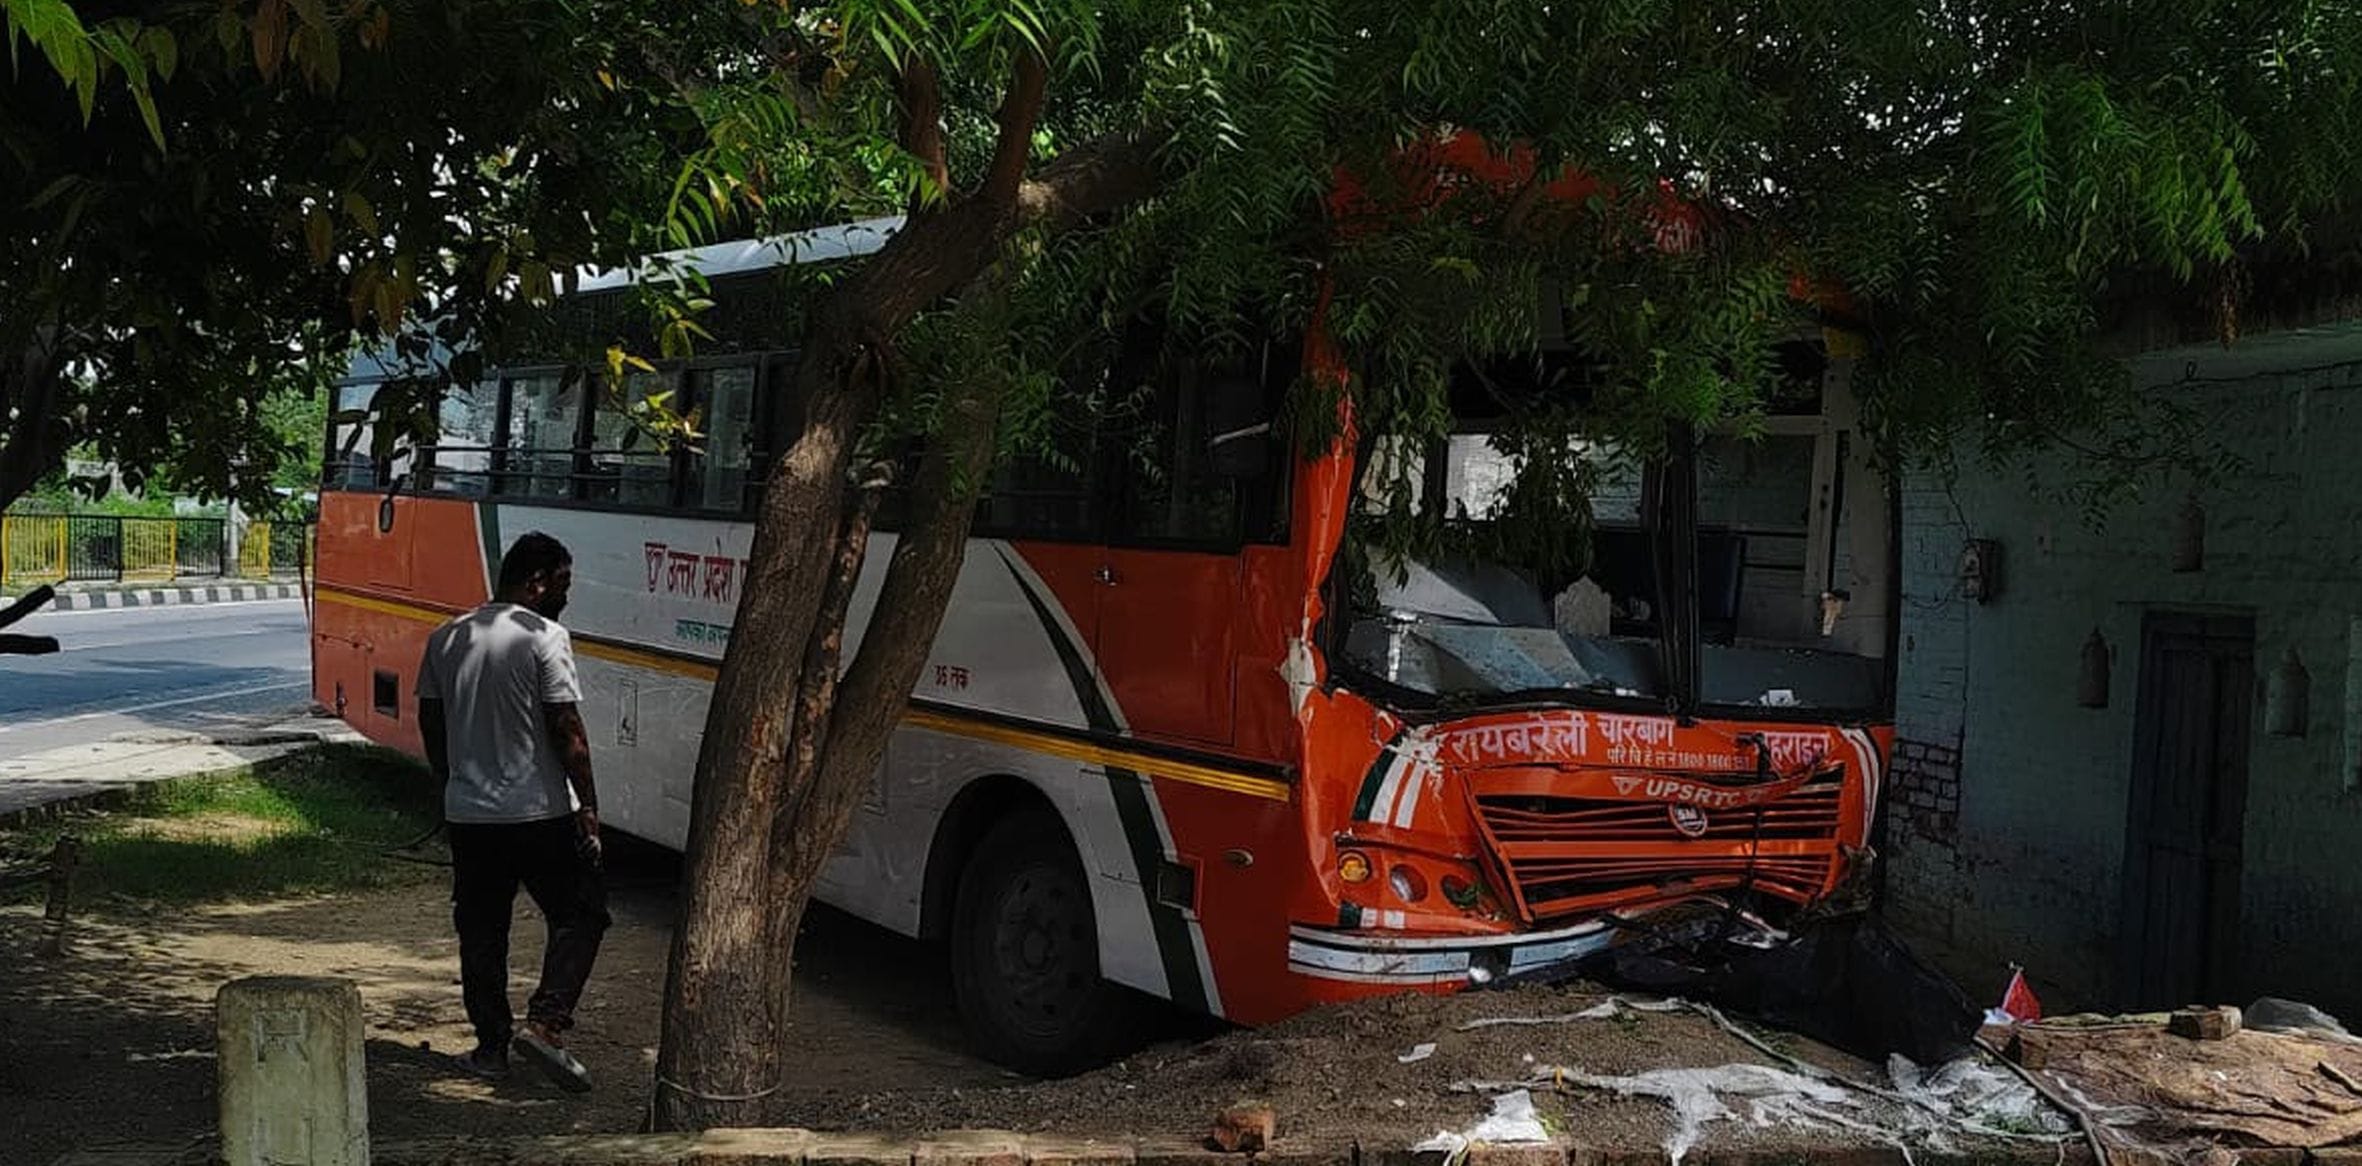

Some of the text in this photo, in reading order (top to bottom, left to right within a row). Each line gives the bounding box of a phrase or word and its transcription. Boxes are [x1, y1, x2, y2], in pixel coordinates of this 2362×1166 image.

[1451, 710, 1676, 761] रायबरेली चारबाग
[1645, 778, 1741, 806] UPSRTC
